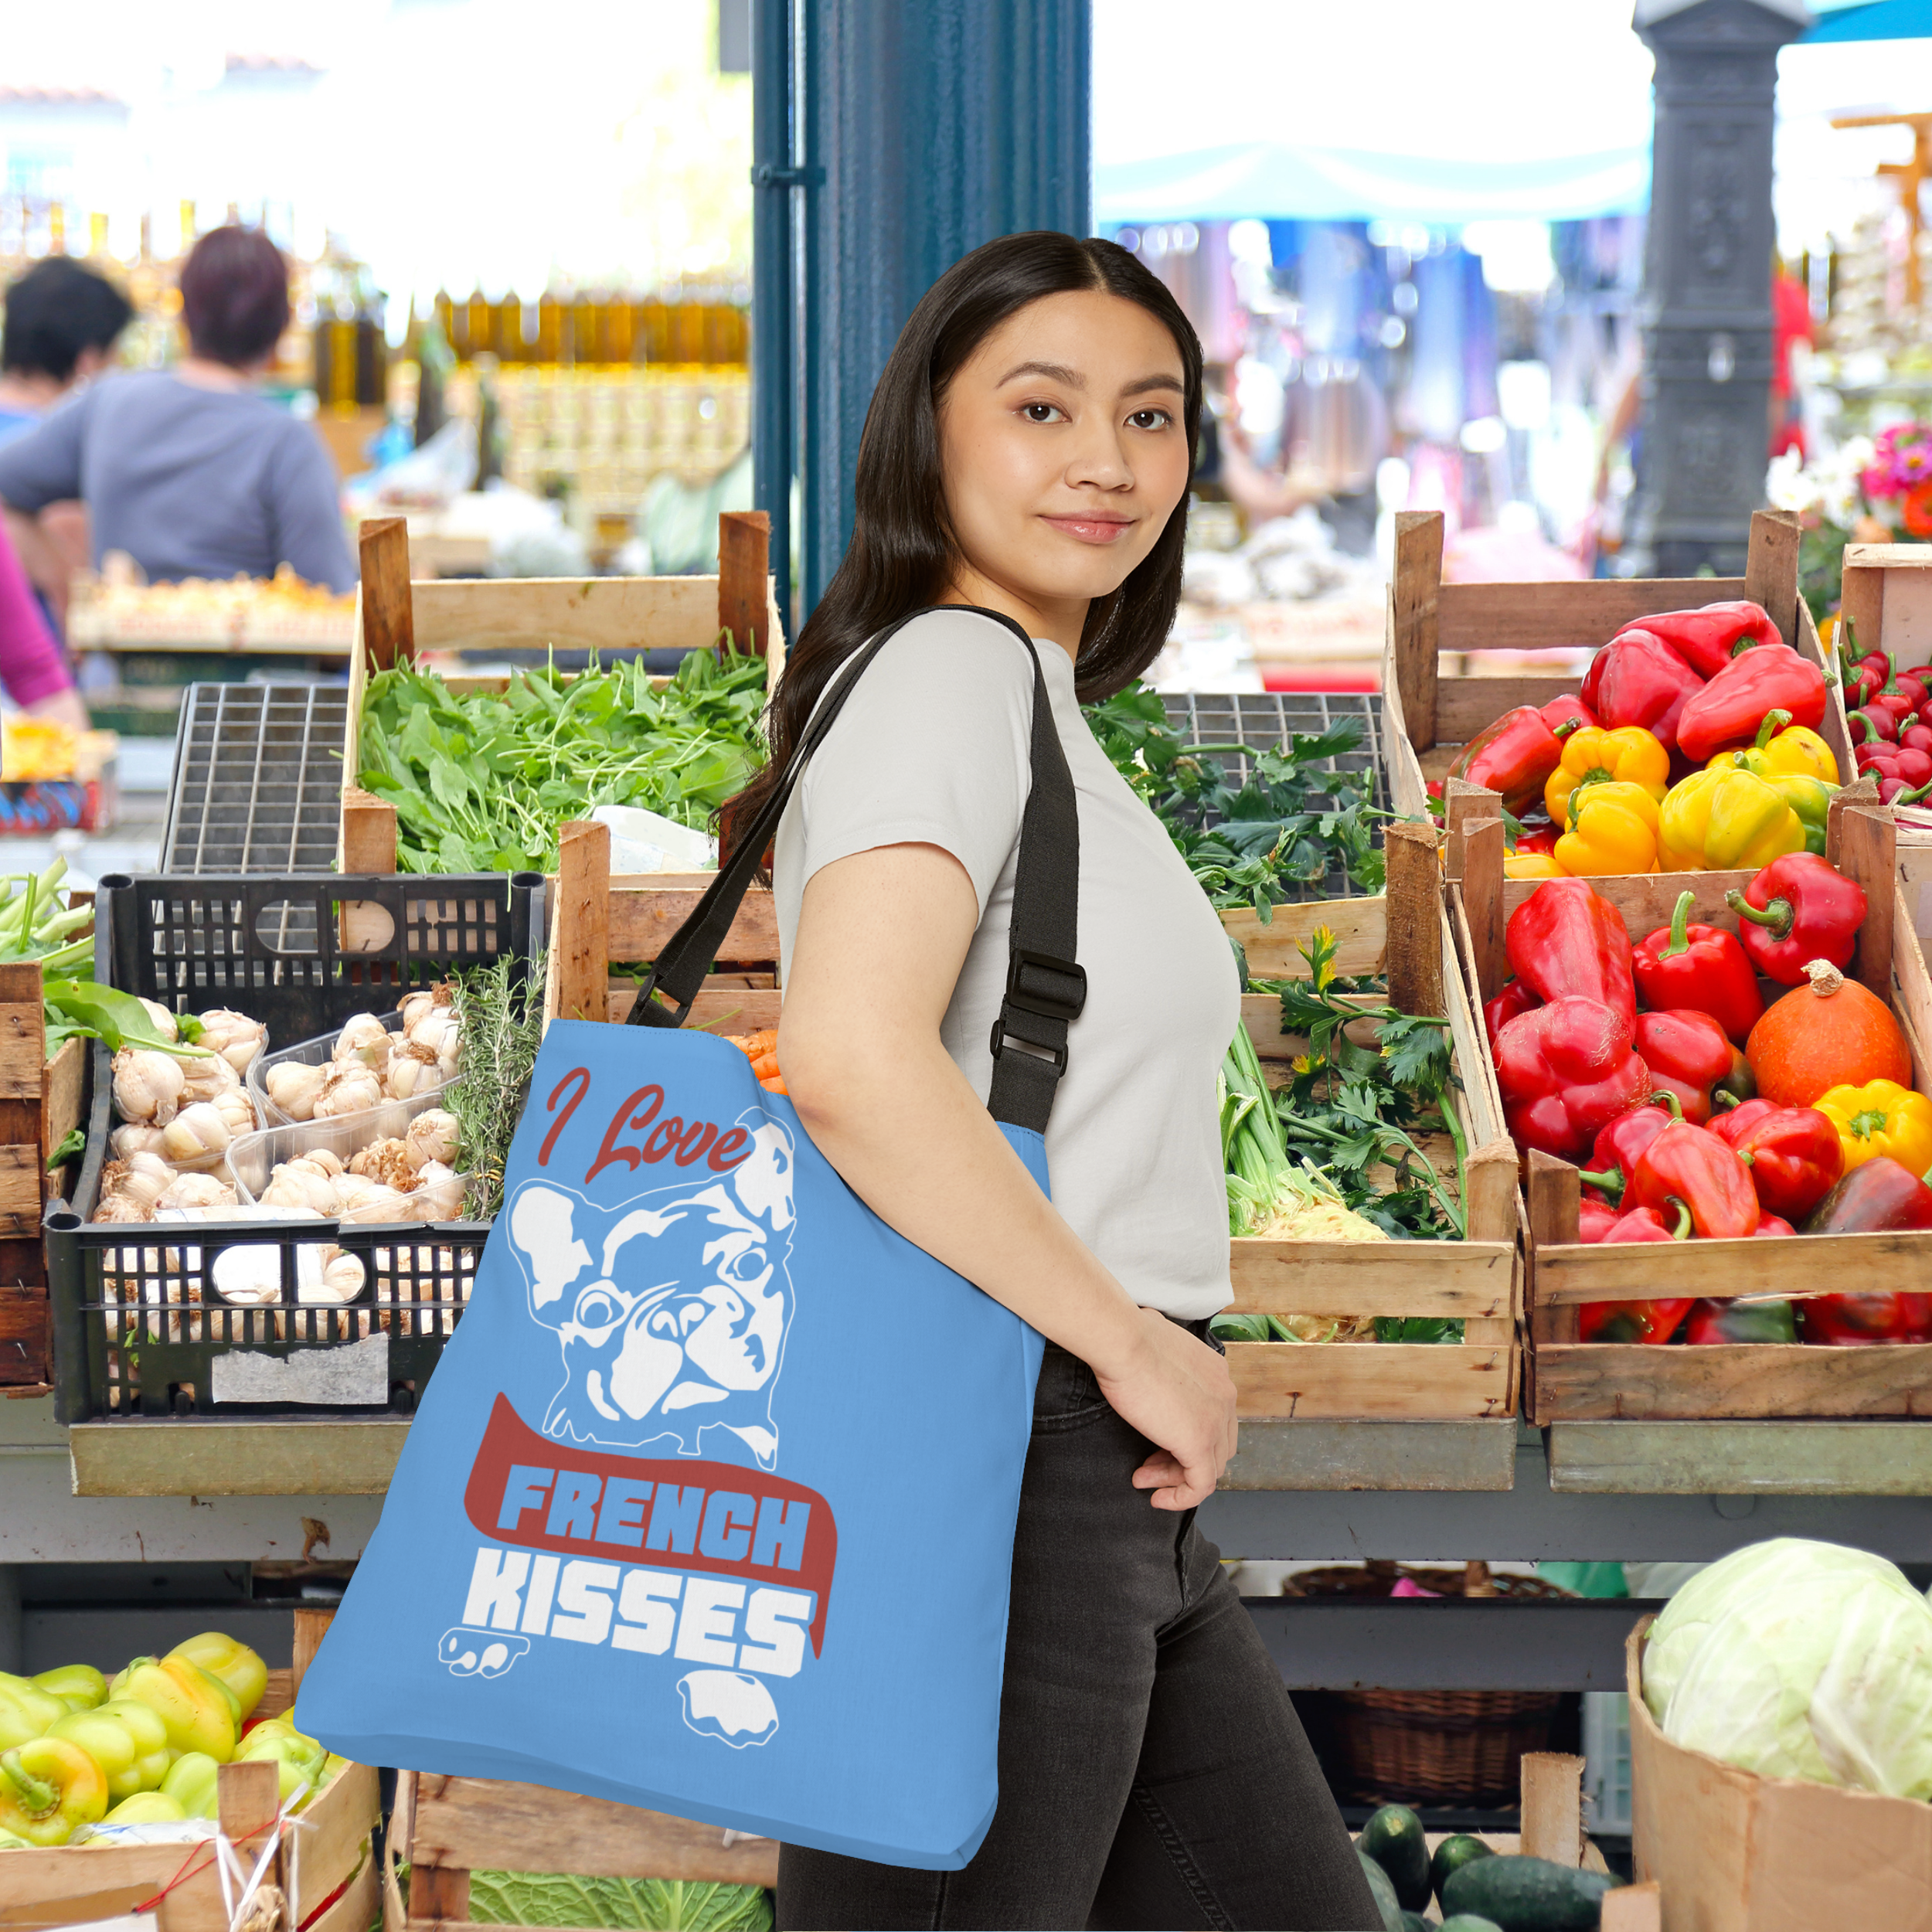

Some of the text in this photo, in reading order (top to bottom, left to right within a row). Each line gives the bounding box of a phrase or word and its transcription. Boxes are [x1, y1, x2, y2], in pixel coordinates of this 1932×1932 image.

[538, 1066, 751, 1185] I Love
[496, 1464, 812, 1572] FRENCH
[461, 1546, 812, 1679] KISSES
